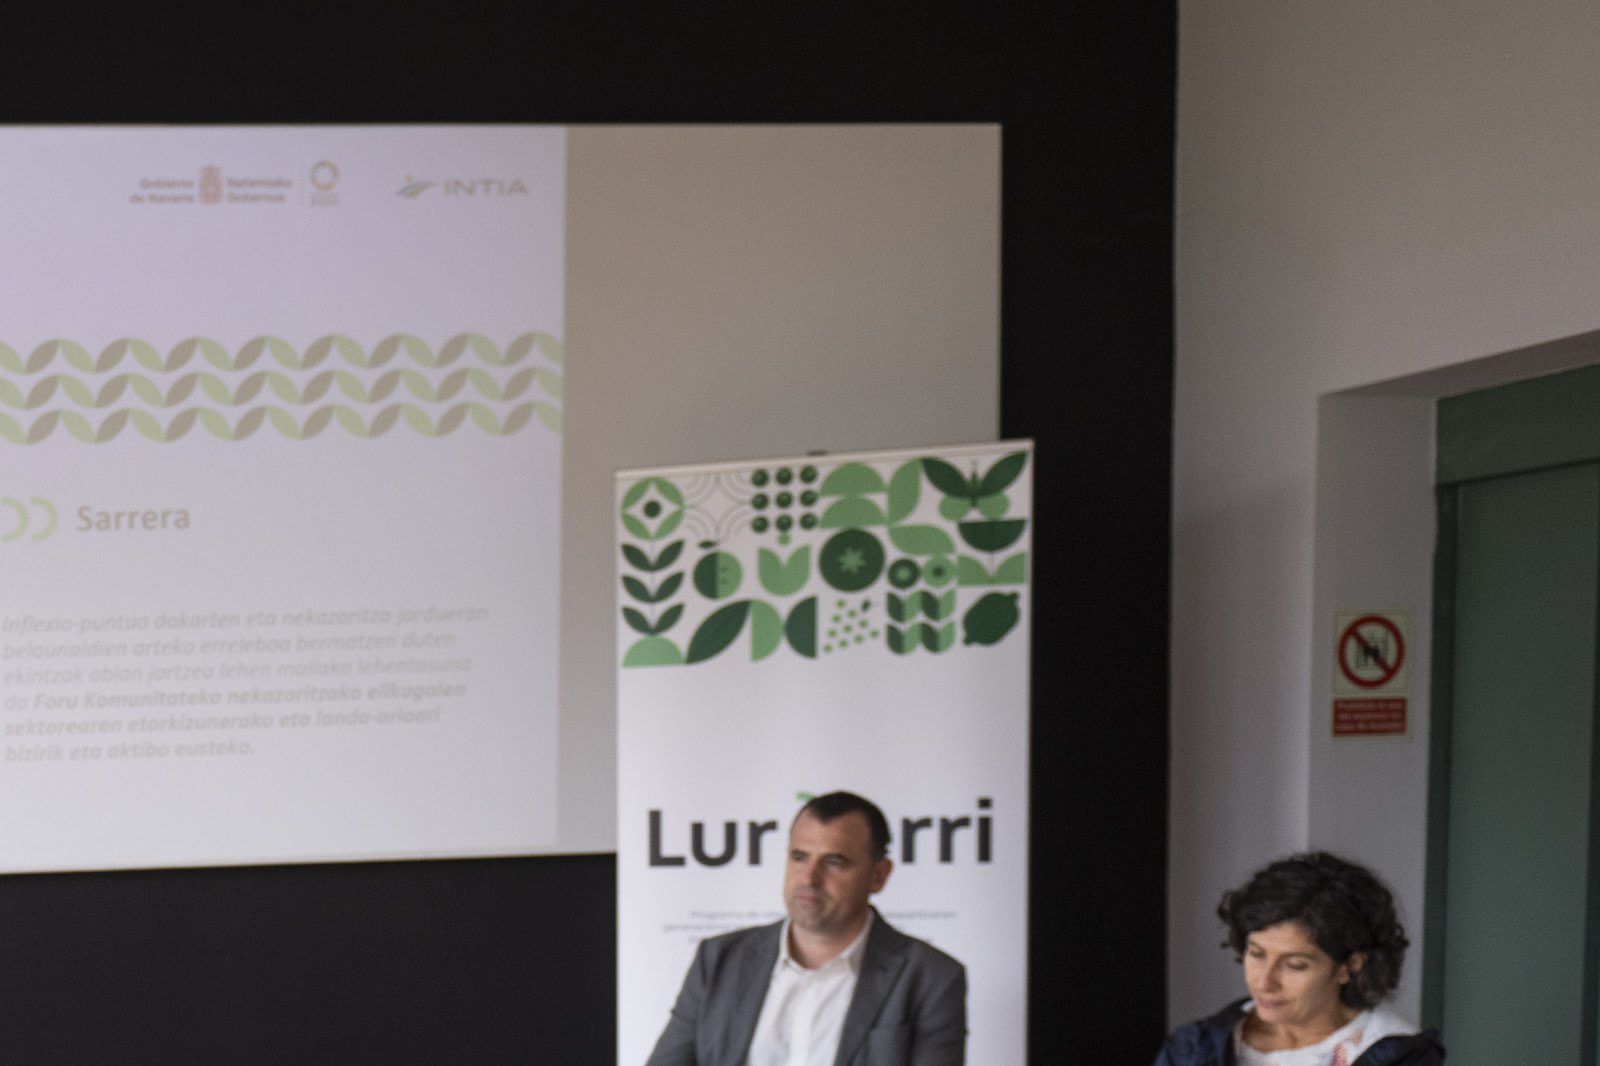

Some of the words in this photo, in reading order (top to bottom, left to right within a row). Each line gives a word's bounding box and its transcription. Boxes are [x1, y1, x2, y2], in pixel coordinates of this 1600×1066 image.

[444, 179, 528, 195] INTIA
[75, 504, 191, 533] Sarrera
[246, 611, 277, 626] eta
[647, 792, 993, 867] Lurrri
